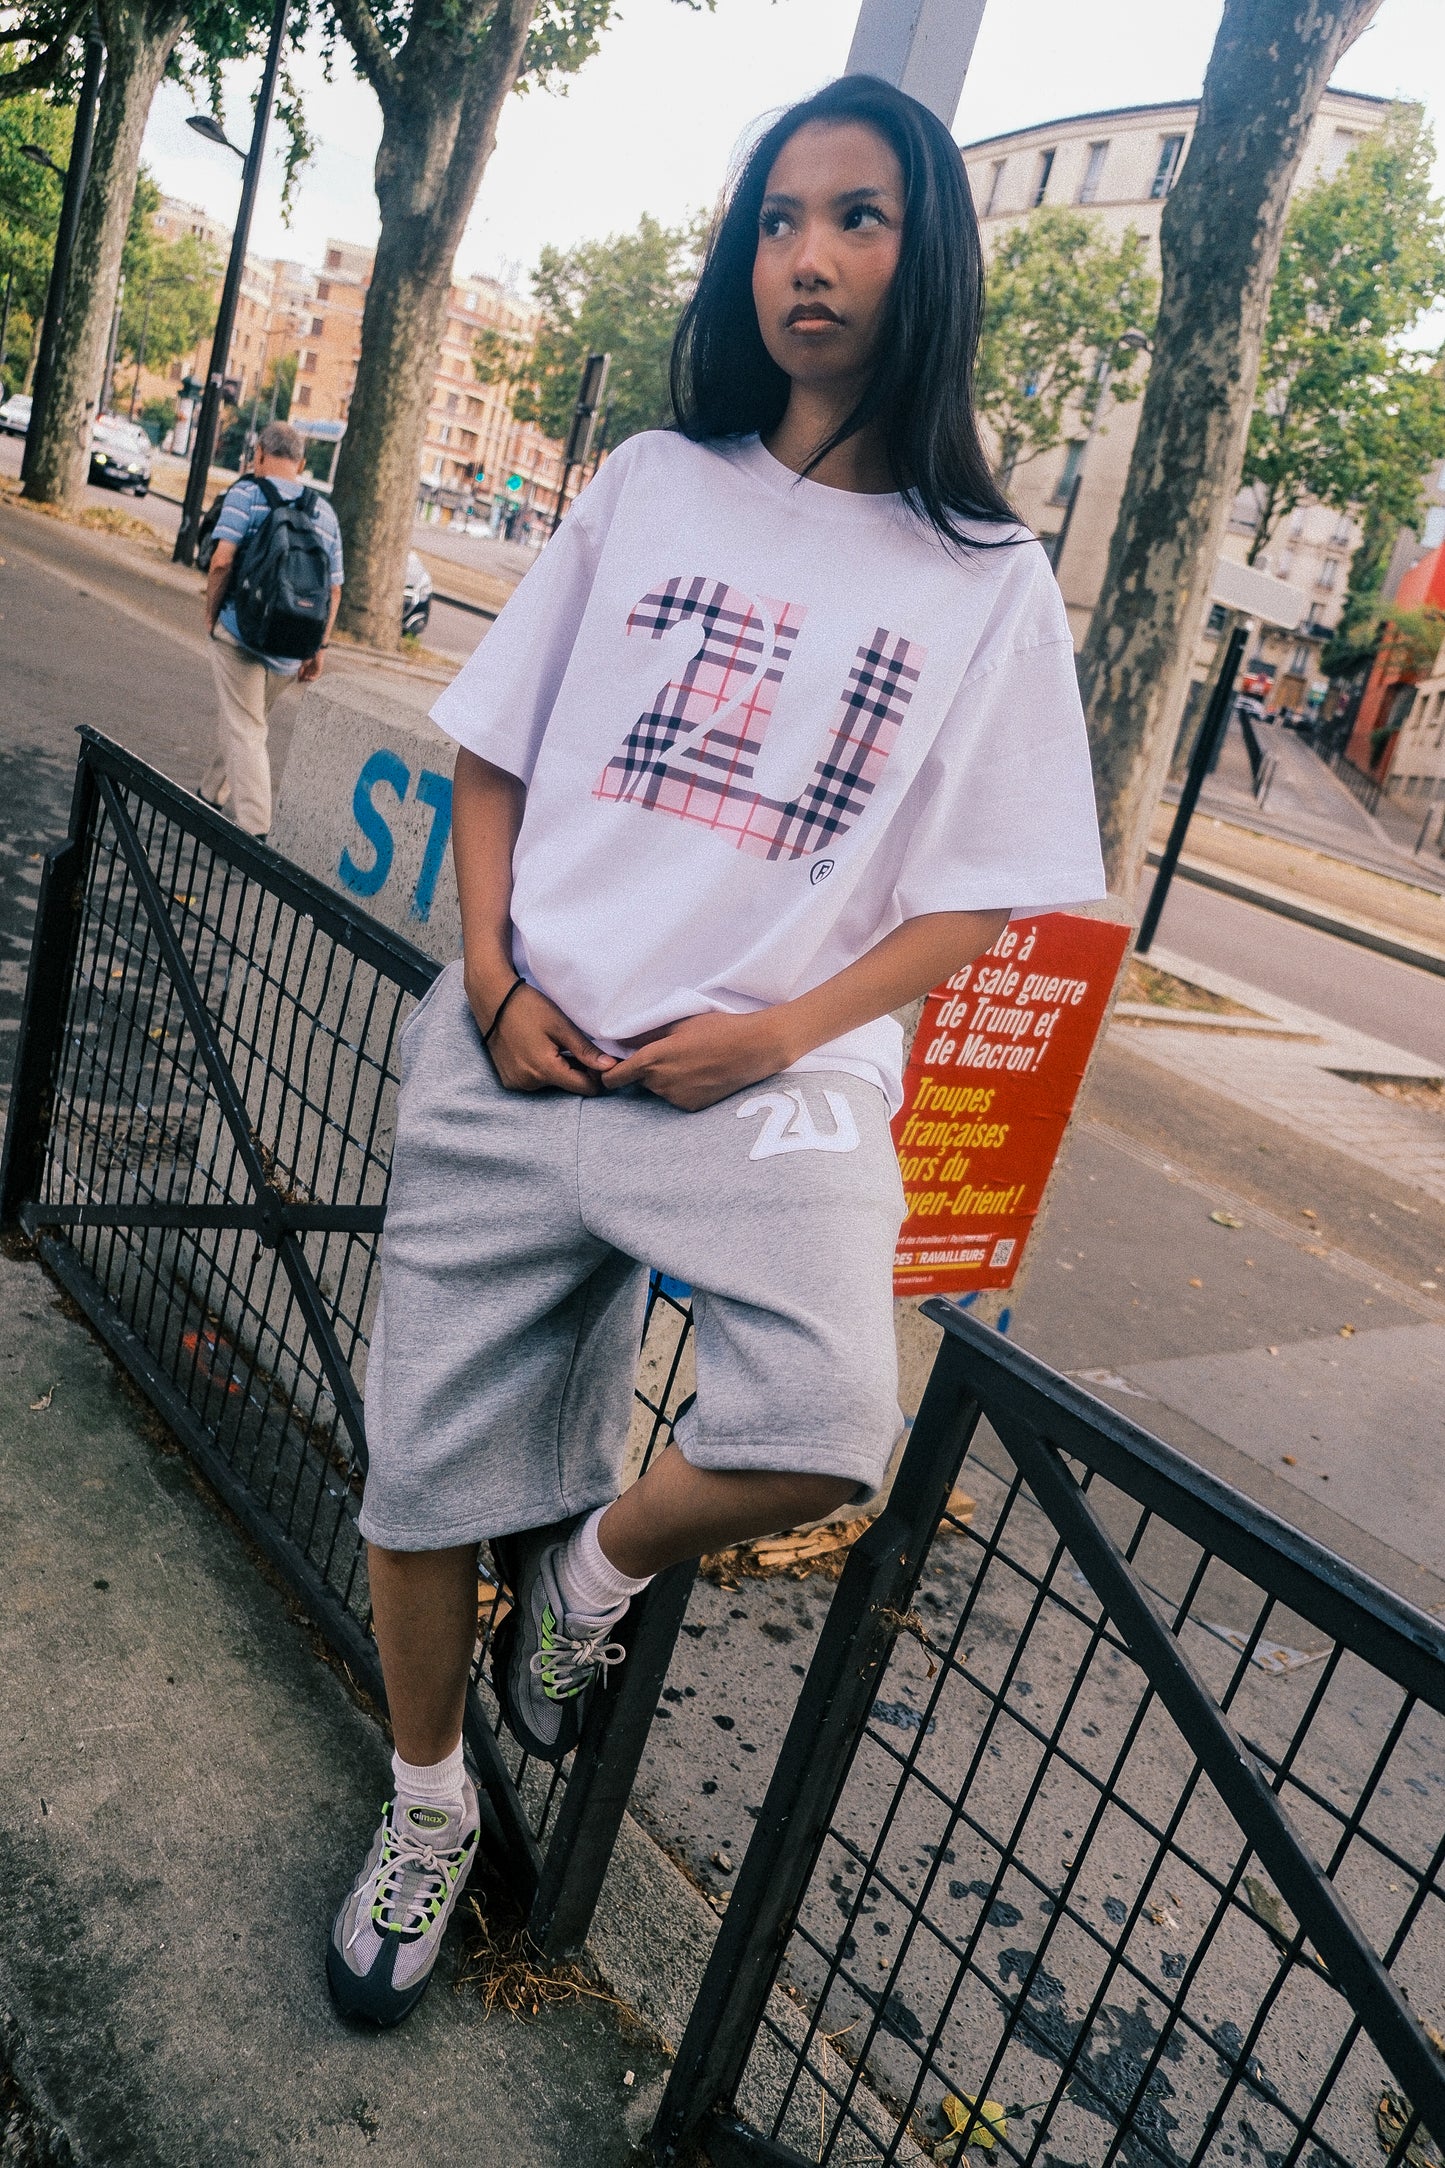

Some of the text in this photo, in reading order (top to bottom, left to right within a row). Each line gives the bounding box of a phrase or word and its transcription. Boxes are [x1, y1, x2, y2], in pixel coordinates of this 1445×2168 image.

[985, 925, 1037, 961] te à
[972, 962, 1020, 997] sale
[1015, 973, 1088, 1006] guerre
[935, 993, 1061, 1042] de Trump et
[924, 1031, 956, 1065] de
[911, 1076, 996, 1118] Troupes
[898, 1113, 1010, 1156] françaises
[939, 1150, 970, 1182] du
[914, 1248, 987, 1265] TRAVAILLEURS
